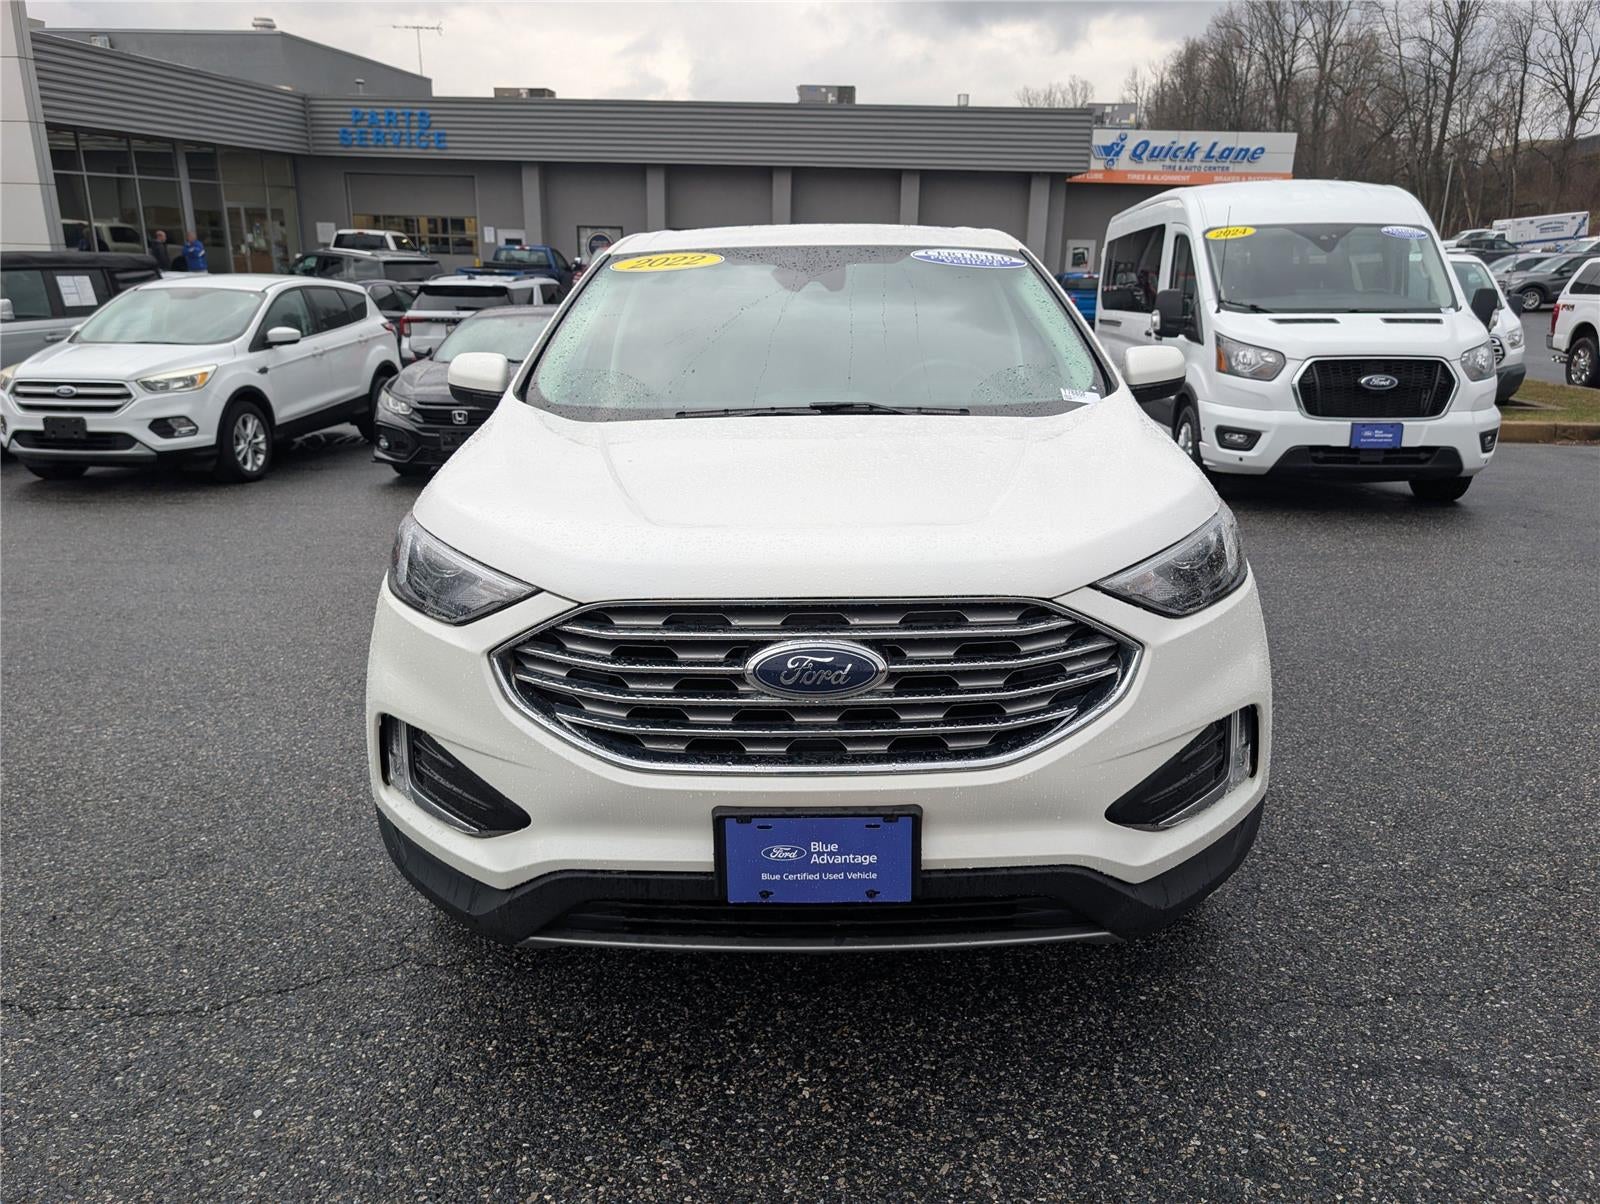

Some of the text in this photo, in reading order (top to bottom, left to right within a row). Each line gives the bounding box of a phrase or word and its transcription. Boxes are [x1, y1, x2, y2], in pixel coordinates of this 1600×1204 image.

[352, 107, 431, 129] PARTS
[338, 128, 447, 149] SERVICE
[1130, 140, 1265, 162] Quick Lane
[1215, 227, 1248, 238] 2024
[627, 255, 706, 270] 2022
[1369, 377, 1391, 386] Ford
[779, 655, 852, 686] Ford
[769, 847, 798, 859] Ford
[810, 841, 839, 852] Blue
[810, 852, 878, 866] Advantage
[761, 871, 878, 881] Blue Certified Used Vehicle
